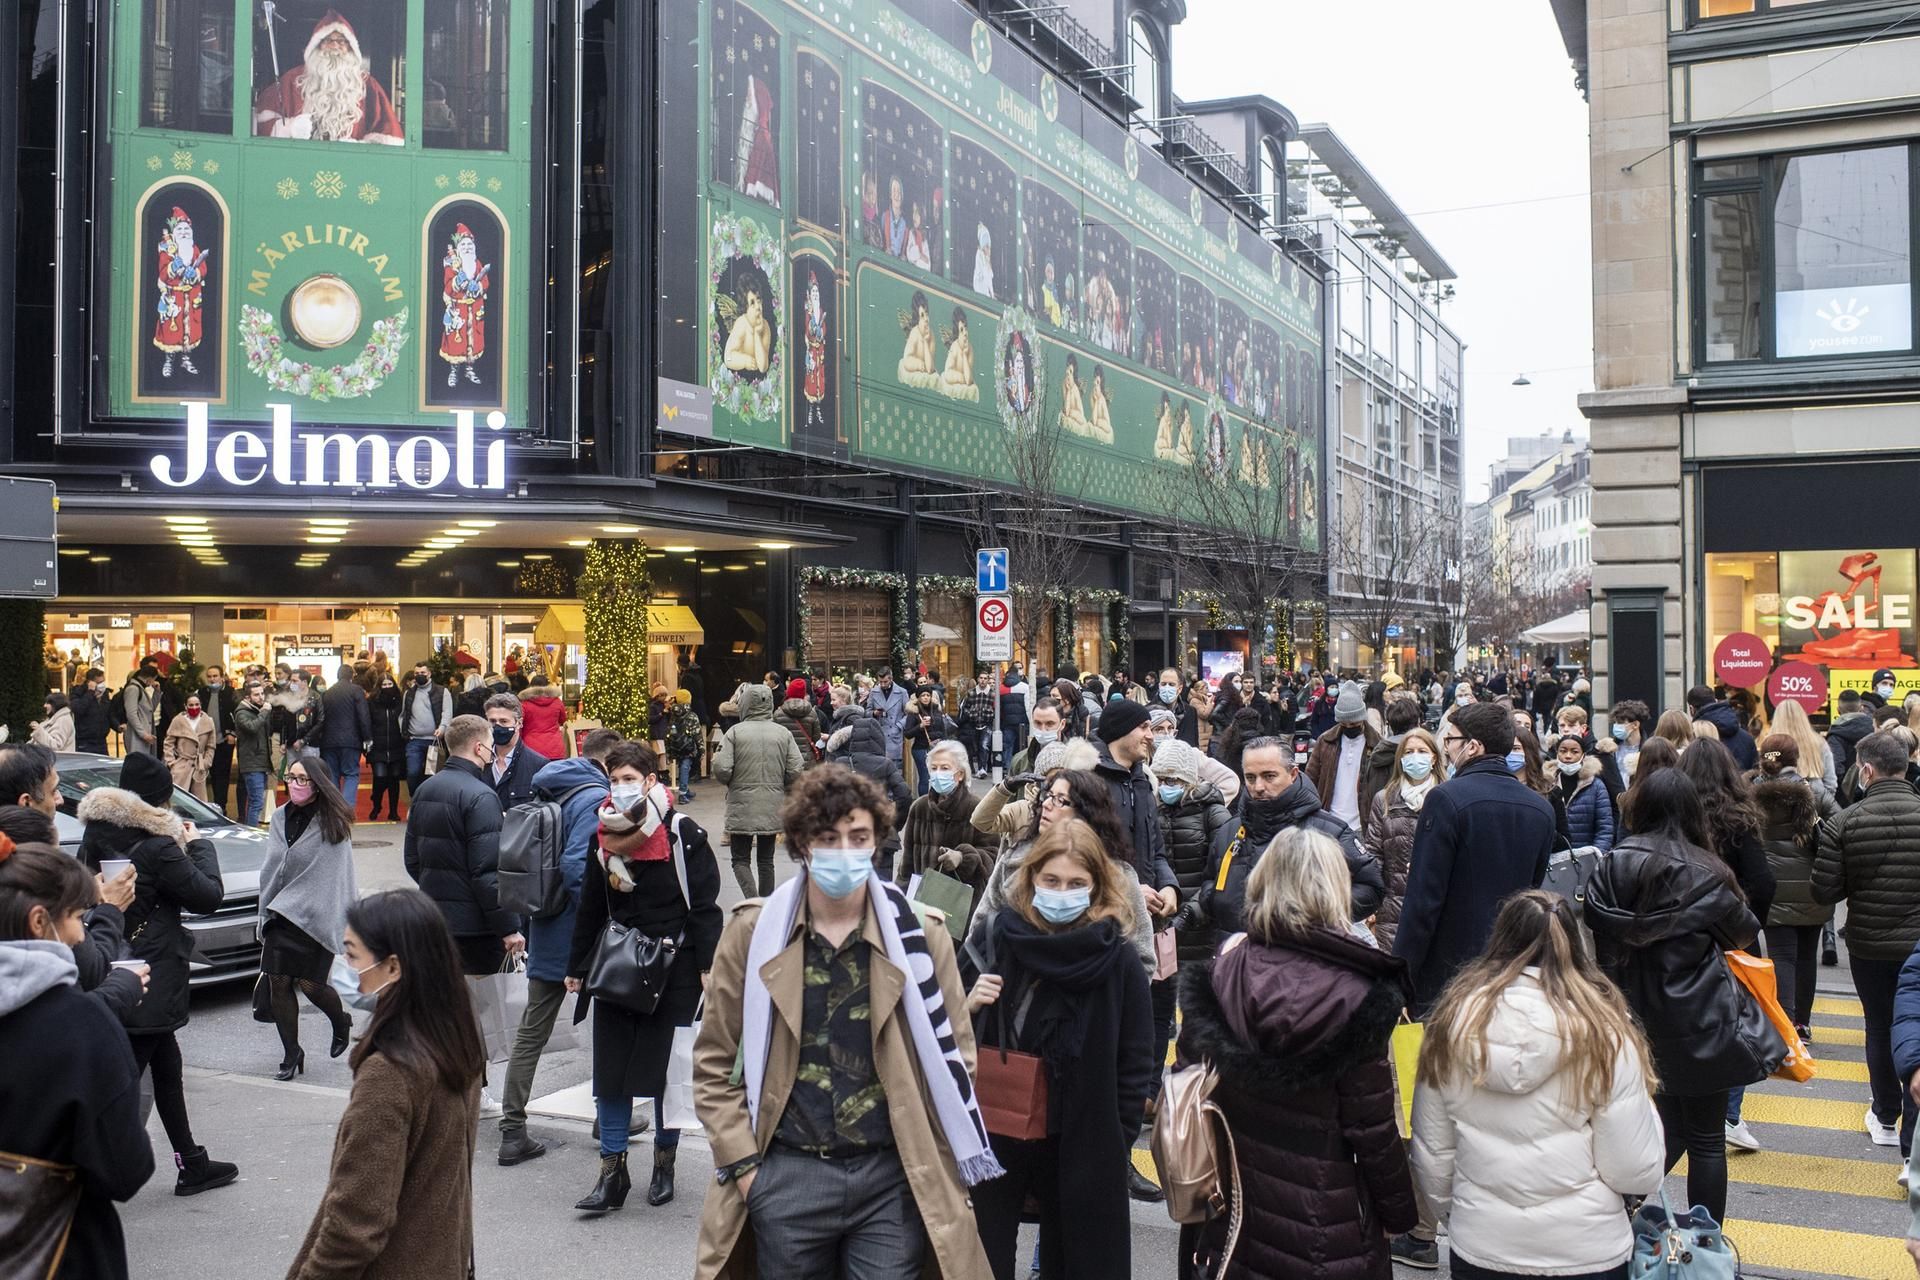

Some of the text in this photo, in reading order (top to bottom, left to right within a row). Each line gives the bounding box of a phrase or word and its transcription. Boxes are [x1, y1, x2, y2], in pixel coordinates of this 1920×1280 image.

[997, 84, 1038, 136] Jelmoli
[246, 224, 404, 303] MÄRLITRAM
[150, 401, 507, 489] Jelmoli
[1784, 593, 1912, 630] SALE
[111, 617, 131, 628] Dior
[285, 647, 334, 656] GUERLAIN
[1731, 649, 1750, 657] Total
[1721, 659, 1764, 669] Liquidation
[1780, 676, 1813, 692] 50%
[1839, 680, 1920, 688] LETZ AGE
